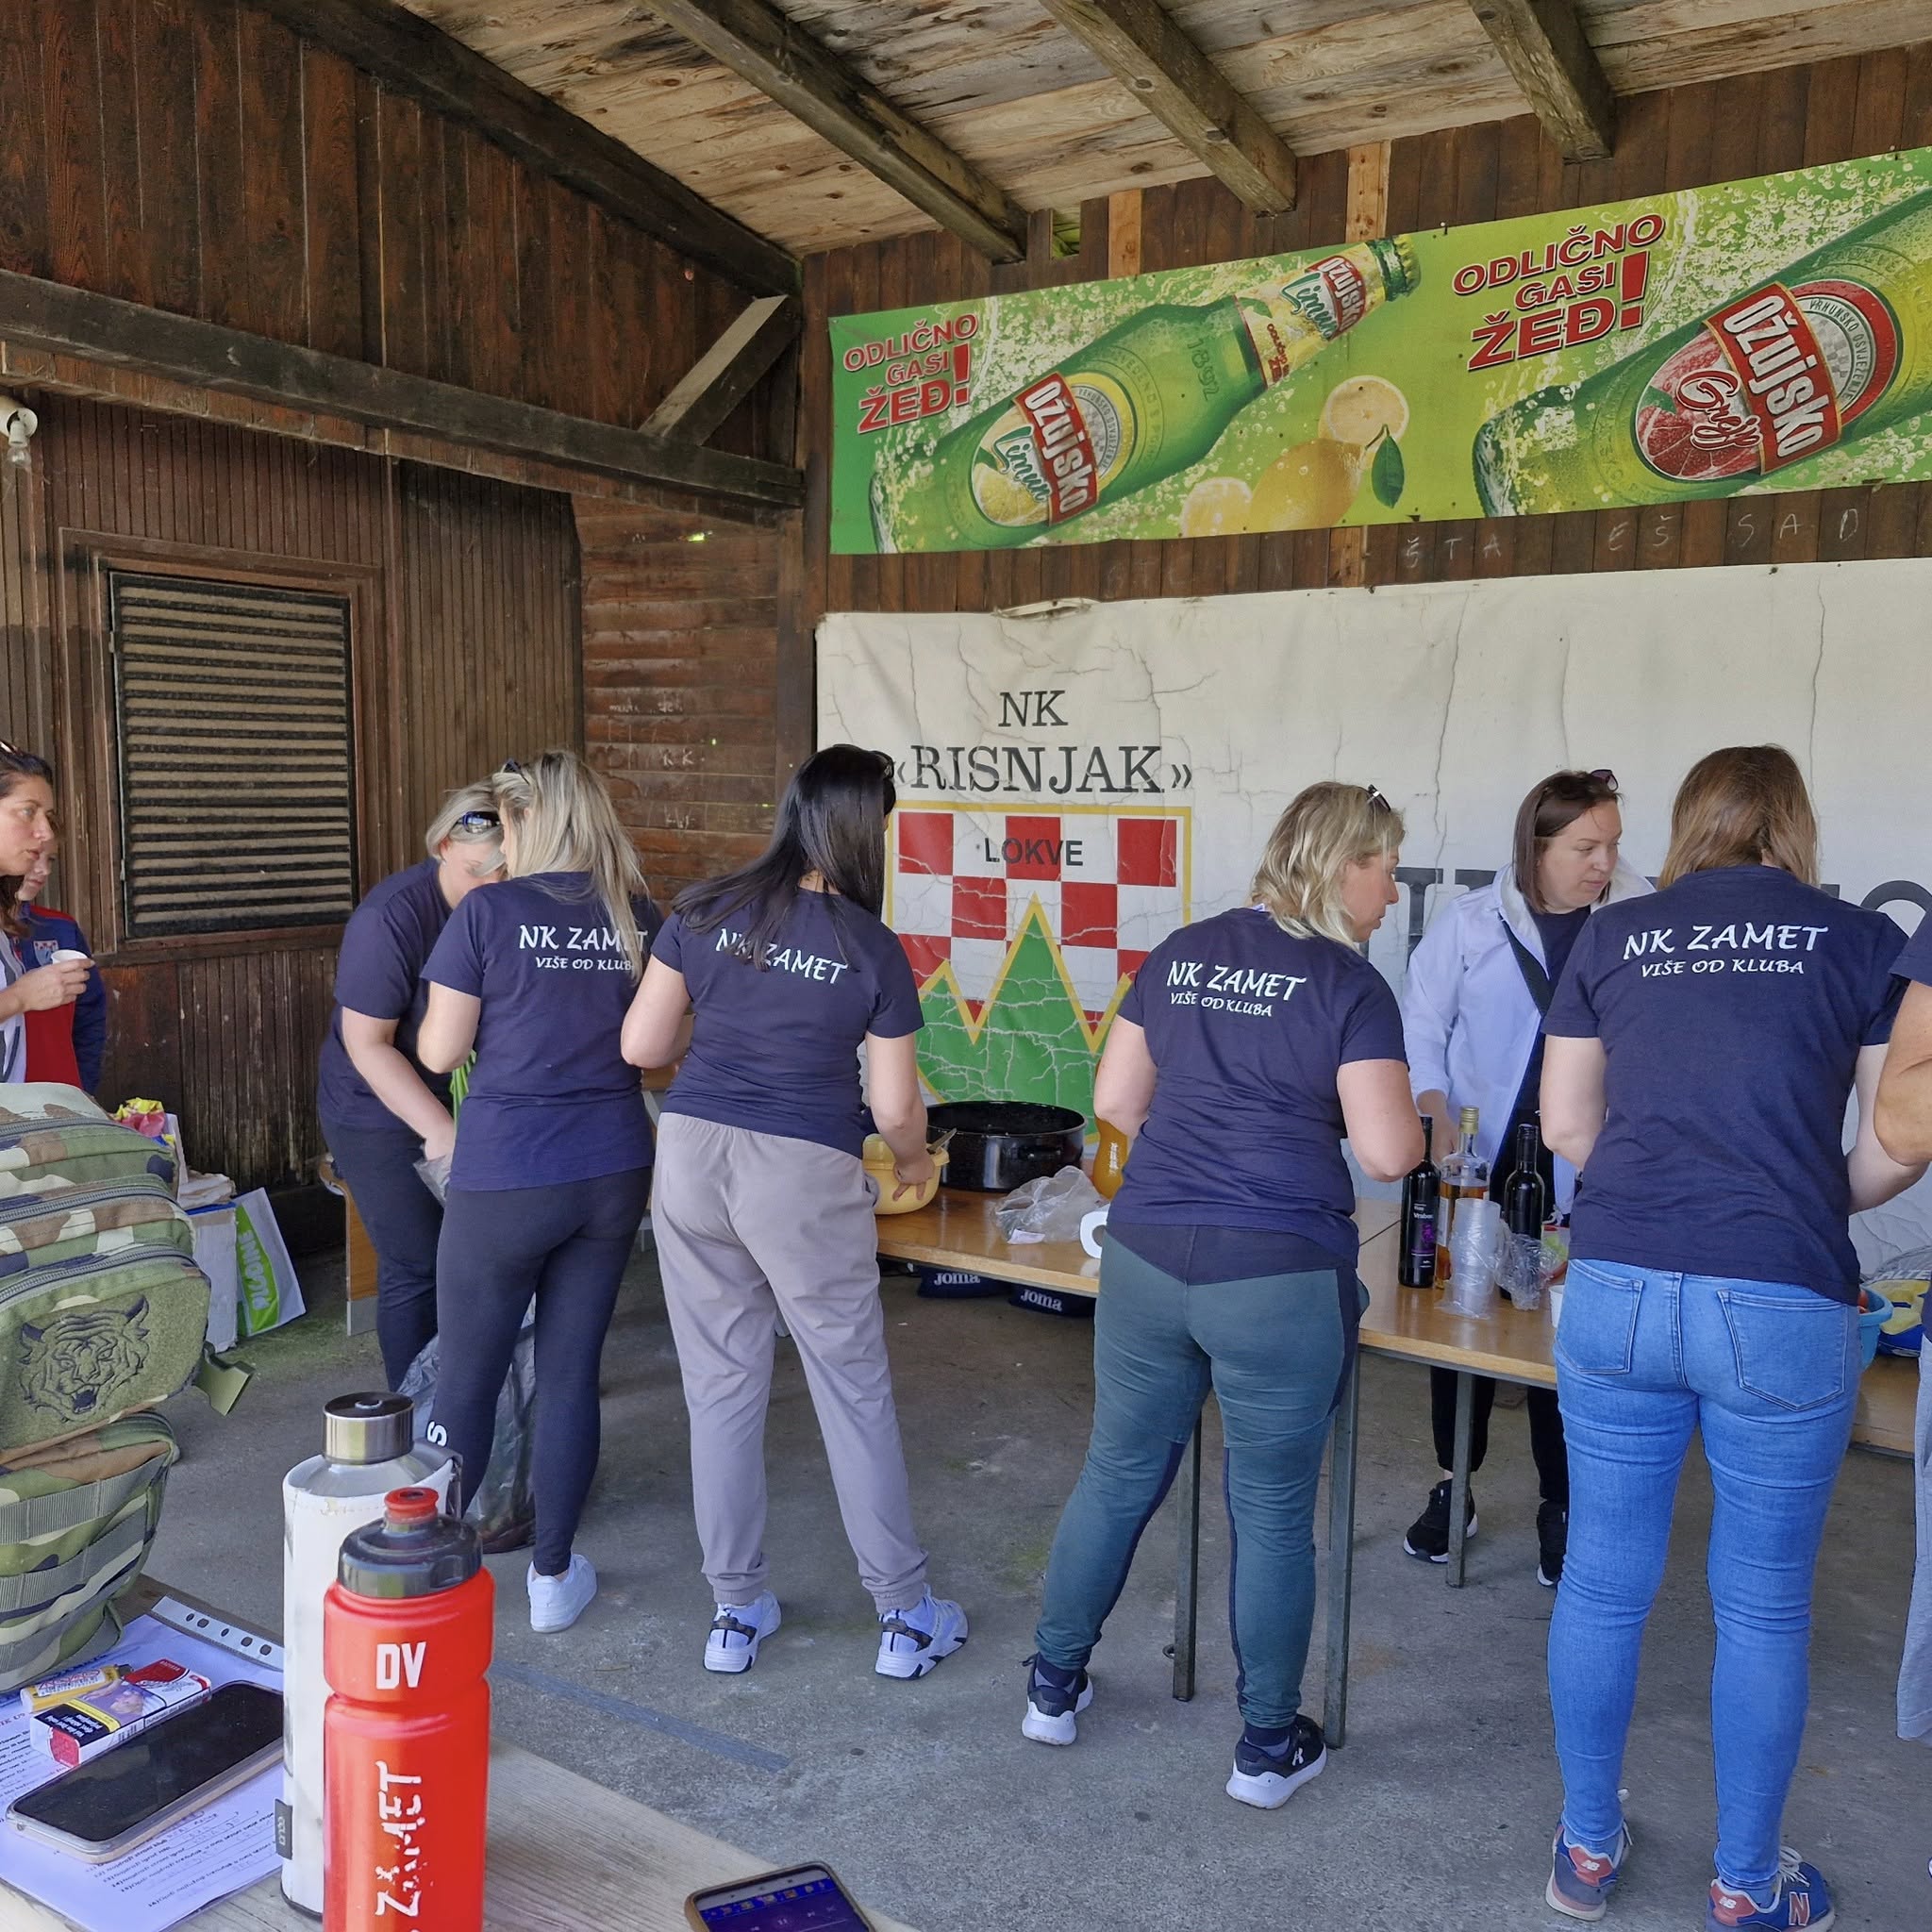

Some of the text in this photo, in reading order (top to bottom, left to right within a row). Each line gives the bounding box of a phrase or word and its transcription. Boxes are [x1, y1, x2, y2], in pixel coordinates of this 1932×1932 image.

[1453, 213, 1665, 294] ODLIČNO
[1514, 261, 1616, 310] GASI
[1809, 297, 1859, 332] VRHUNSKO
[842, 313, 978, 372] ODLIČNO
[885, 351, 950, 387] GASI
[998, 690, 1069, 727] NK
[984, 837, 1084, 866] LOKVE
[519, 924, 649, 953] NK ZAMT
[1623, 922, 1830, 960] NK ZAMET
[535, 955, 569, 970] VIŠE
[572, 958, 593, 971] OD
[1166, 960, 1307, 1001] NK ZAMET
[1641, 958, 1806, 977] VIŠE OD KLUBA
[1170, 991, 1273, 1017] VIŠE OD KLUBA
[375, 1641, 426, 1690] DV
[1788, 1891, 1811, 1926] N
